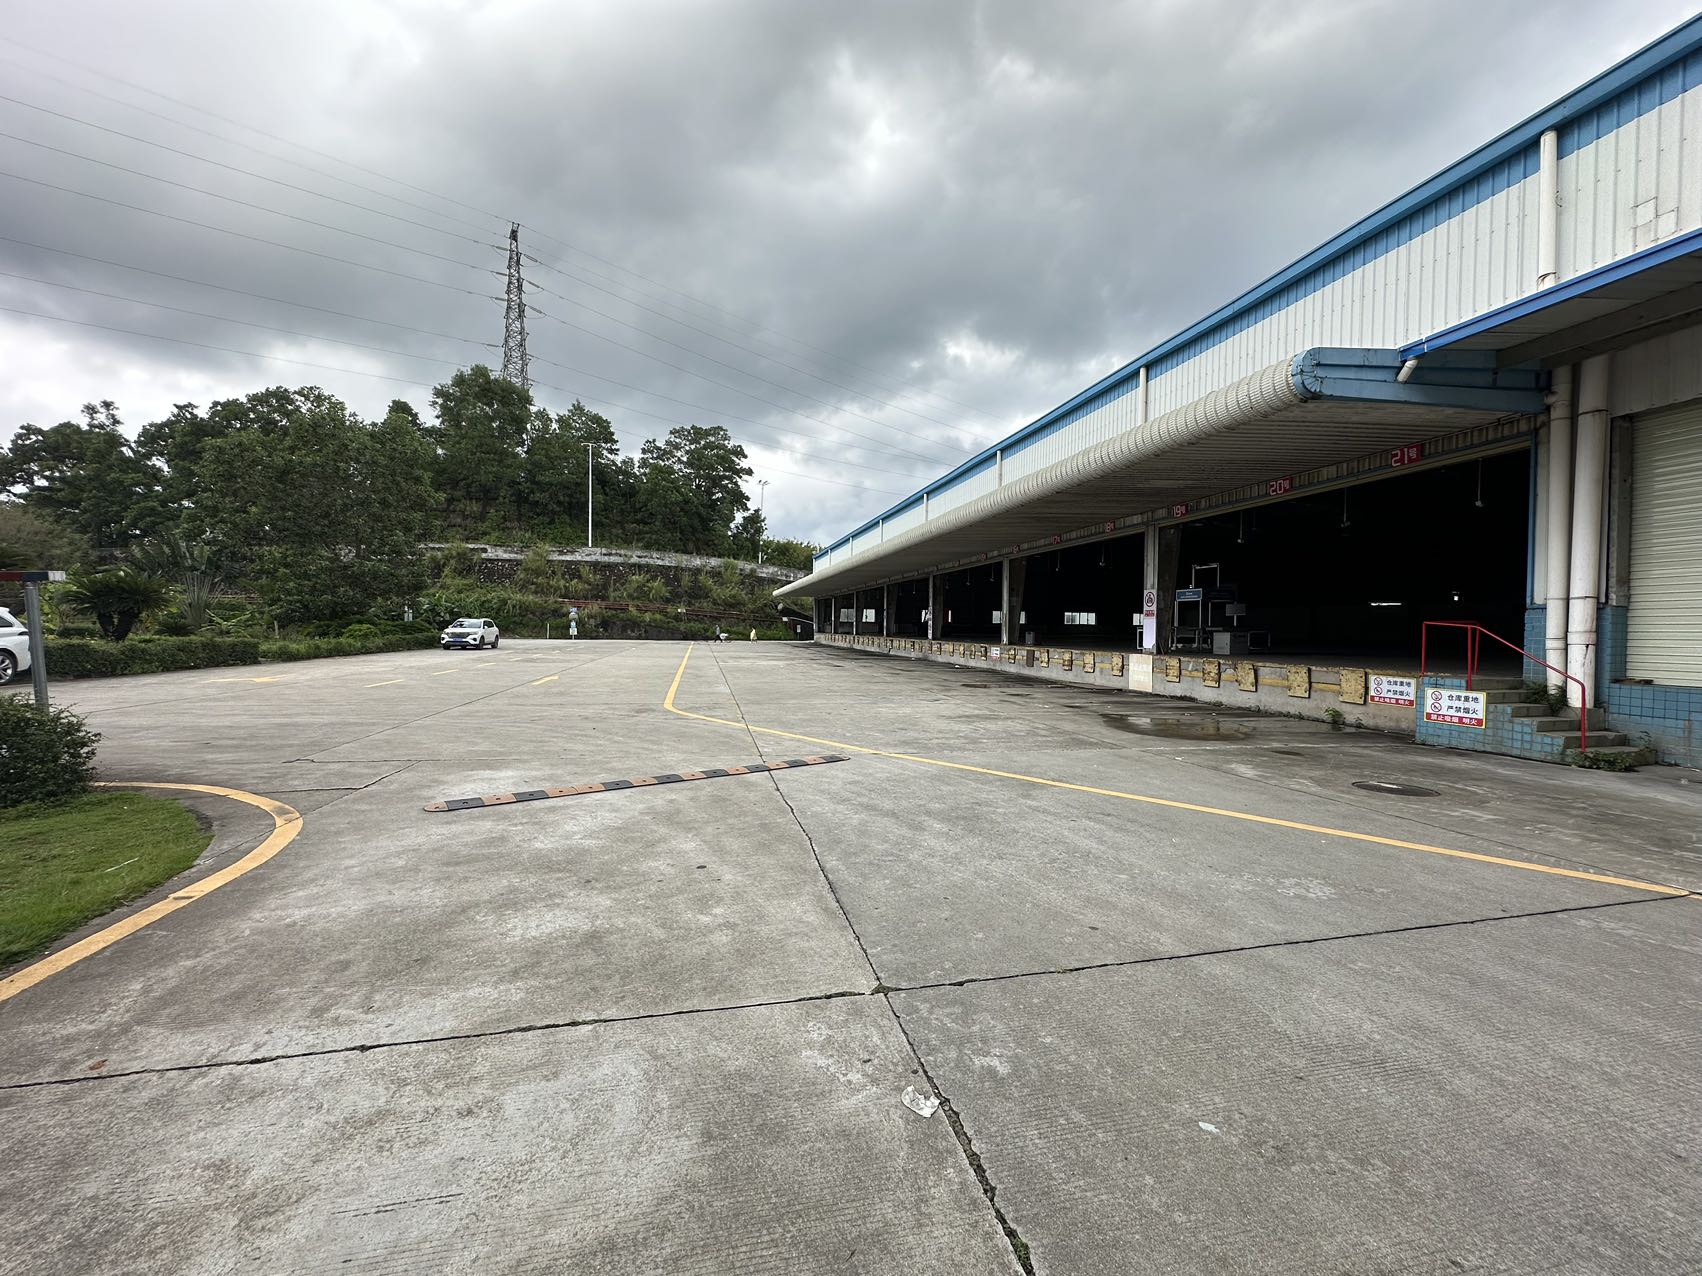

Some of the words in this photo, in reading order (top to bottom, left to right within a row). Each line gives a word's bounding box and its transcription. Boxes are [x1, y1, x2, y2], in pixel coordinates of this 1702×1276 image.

[1386, 679, 1412, 688] 仓库重地
[1386, 689, 1411, 698] 严禁烟火
[1447, 693, 1480, 703] 仓库重地
[1446, 705, 1478, 715] 严禁烟火
[1430, 713, 1459, 723] 禁止吸烟
[1462, 717, 1478, 725] 明火
